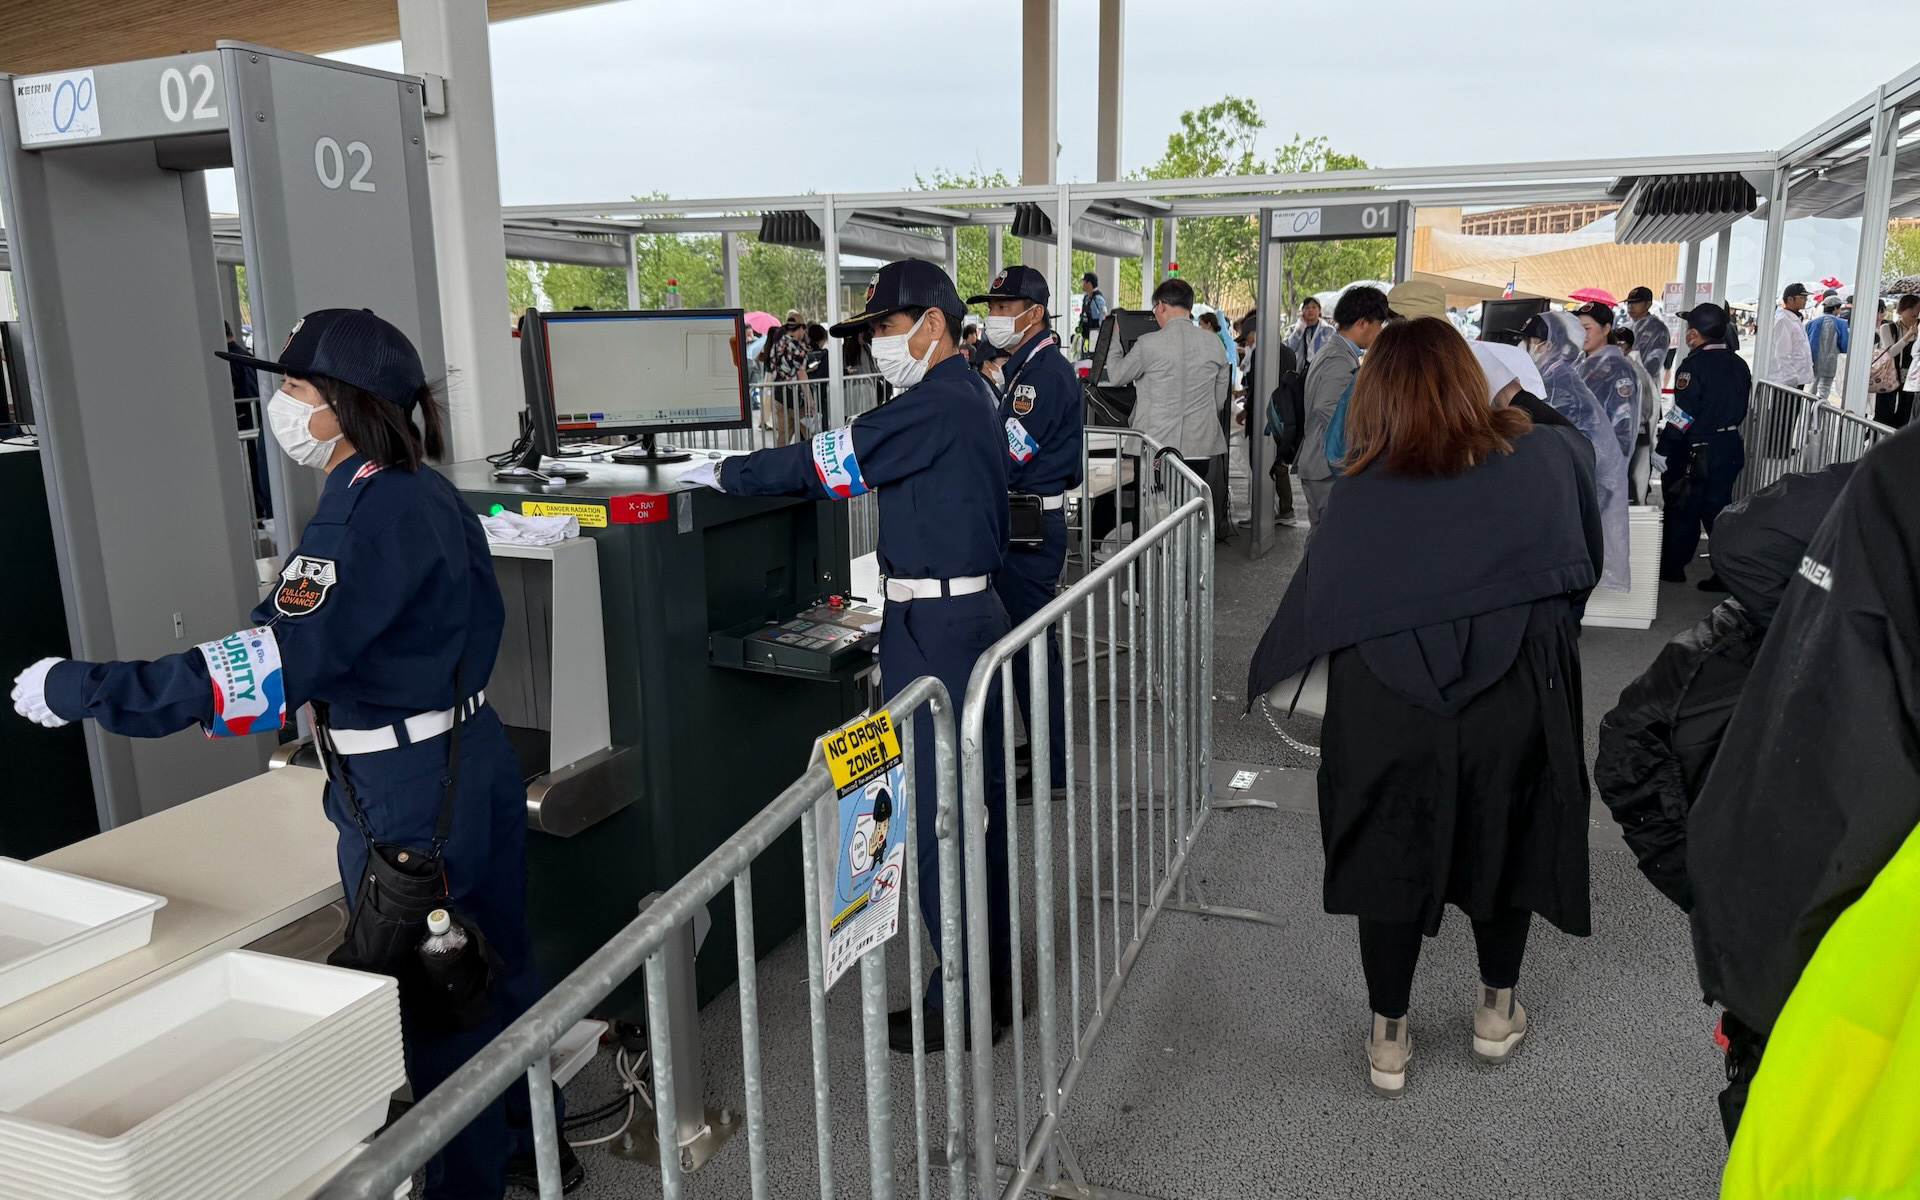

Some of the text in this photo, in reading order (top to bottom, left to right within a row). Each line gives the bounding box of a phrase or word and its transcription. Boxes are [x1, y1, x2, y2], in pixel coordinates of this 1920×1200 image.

[160, 65, 218, 122] 02
[315, 136, 376, 192] 02
[1361, 206, 1389, 229] 01
[570, 506, 601, 514] RADIATION
[279, 595, 316, 608] ADVANCE
[281, 588, 320, 600] FULLCAST
[828, 716, 890, 760] NO DRONE
[854, 841, 863, 851] Expo
